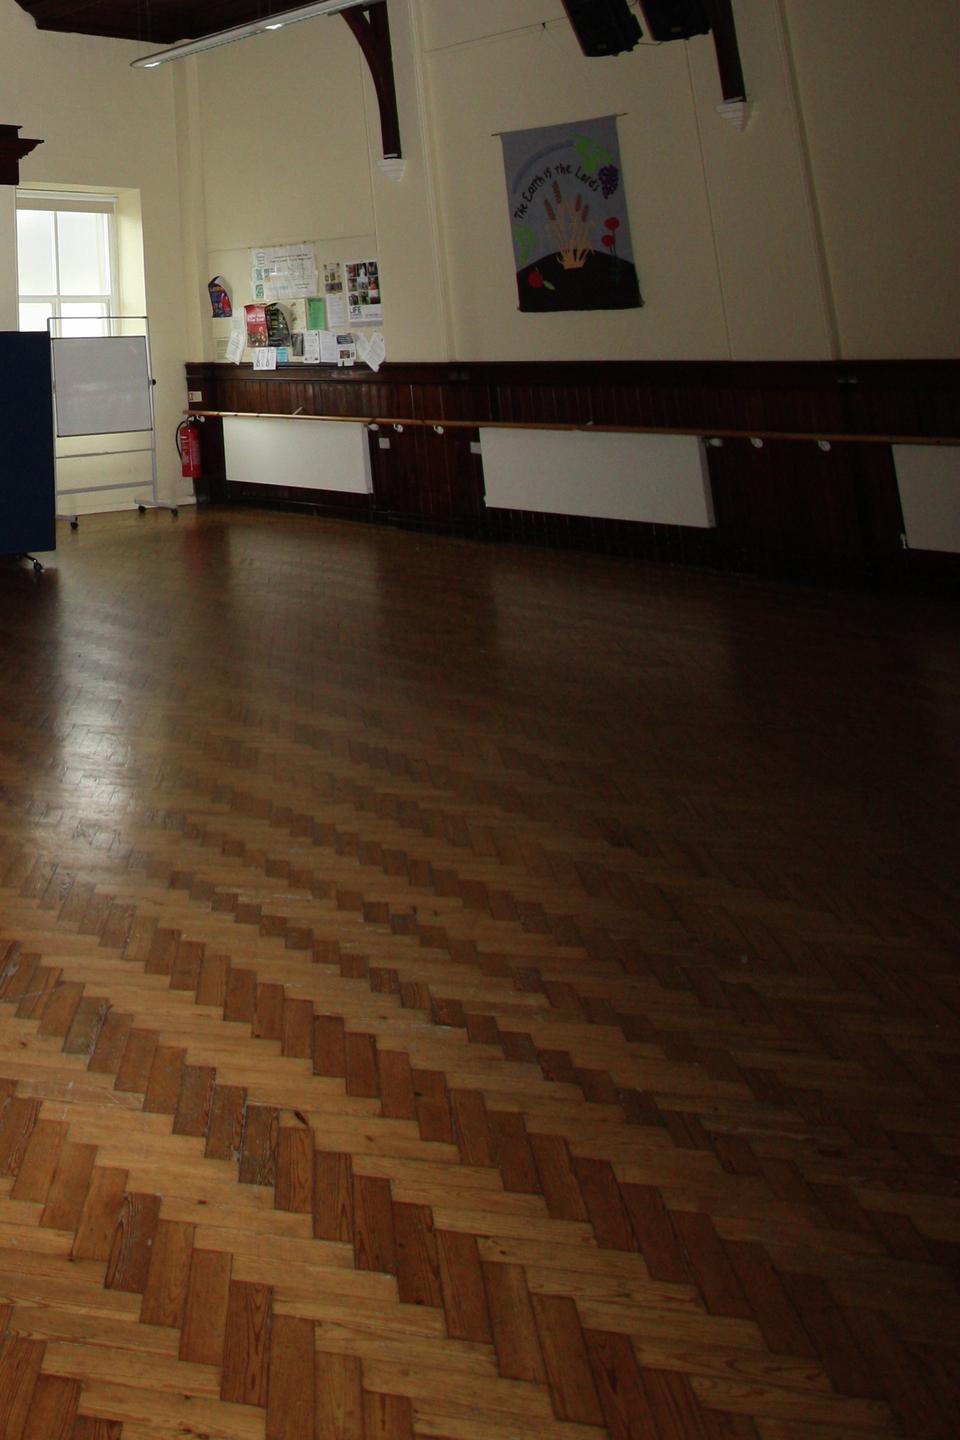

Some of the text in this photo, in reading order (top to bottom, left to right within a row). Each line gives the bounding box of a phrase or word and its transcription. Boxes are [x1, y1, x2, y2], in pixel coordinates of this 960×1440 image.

[514, 203, 528, 219] The
[522, 175, 545, 202] Earth
[543, 167, 552, 179] is
[555, 163, 571, 174] the
